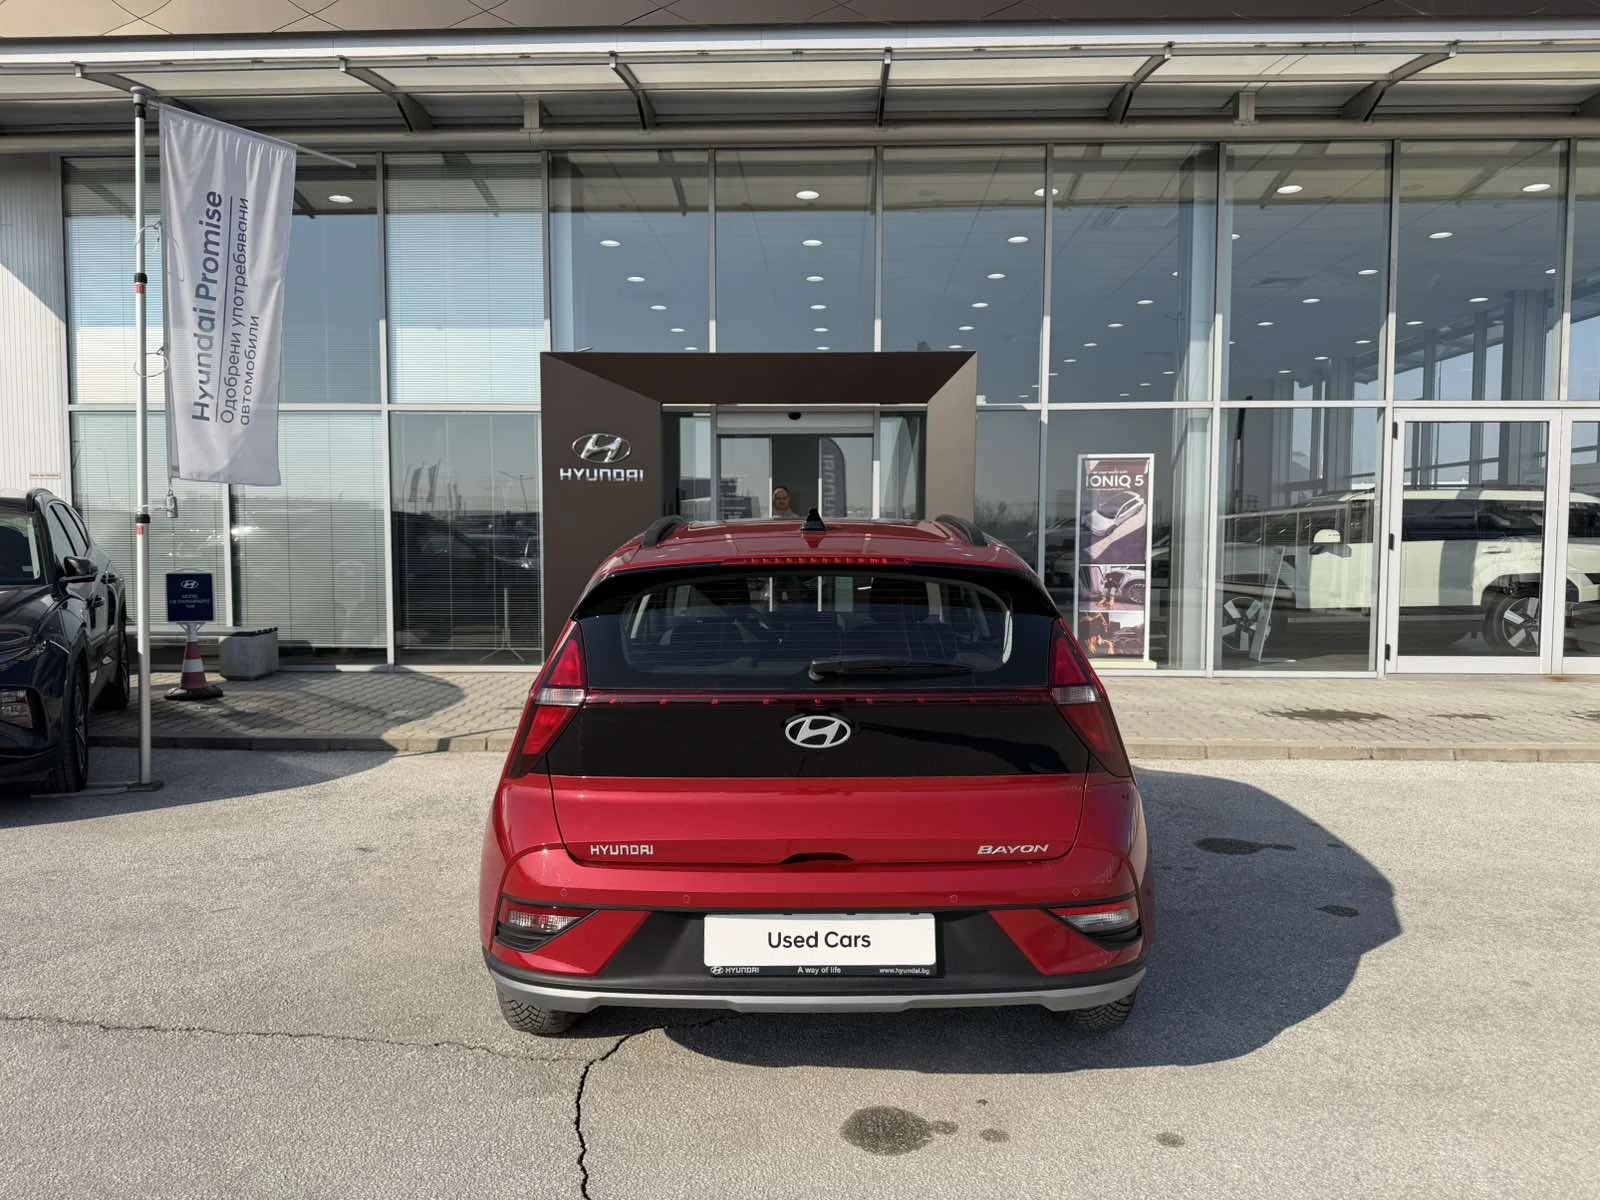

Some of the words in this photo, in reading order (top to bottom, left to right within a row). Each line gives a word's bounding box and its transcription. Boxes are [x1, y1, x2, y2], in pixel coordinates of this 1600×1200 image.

[195, 190, 222, 302] Promise
[220, 332, 242, 424] Одобрени
[232, 198, 249, 327] употребявани
[191, 306, 217, 423] Hyundai
[240, 315, 260, 426] автомобили
[559, 467, 644, 481] HYUNDAI
[1085, 474, 1131, 488] IONIQ
[1134, 474, 1145, 487] 5
[590, 844, 655, 856] HYUNDAI
[977, 843, 1050, 855] BAYON
[767, 930, 819, 949] Used
[824, 930, 872, 949] Cars
[725, 966, 760, 974] HYUNDAI
[797, 966, 804, 974] A
[805, 967, 820, 975] way
[821, 966, 829, 974] of
[830, 966, 842, 974] life
